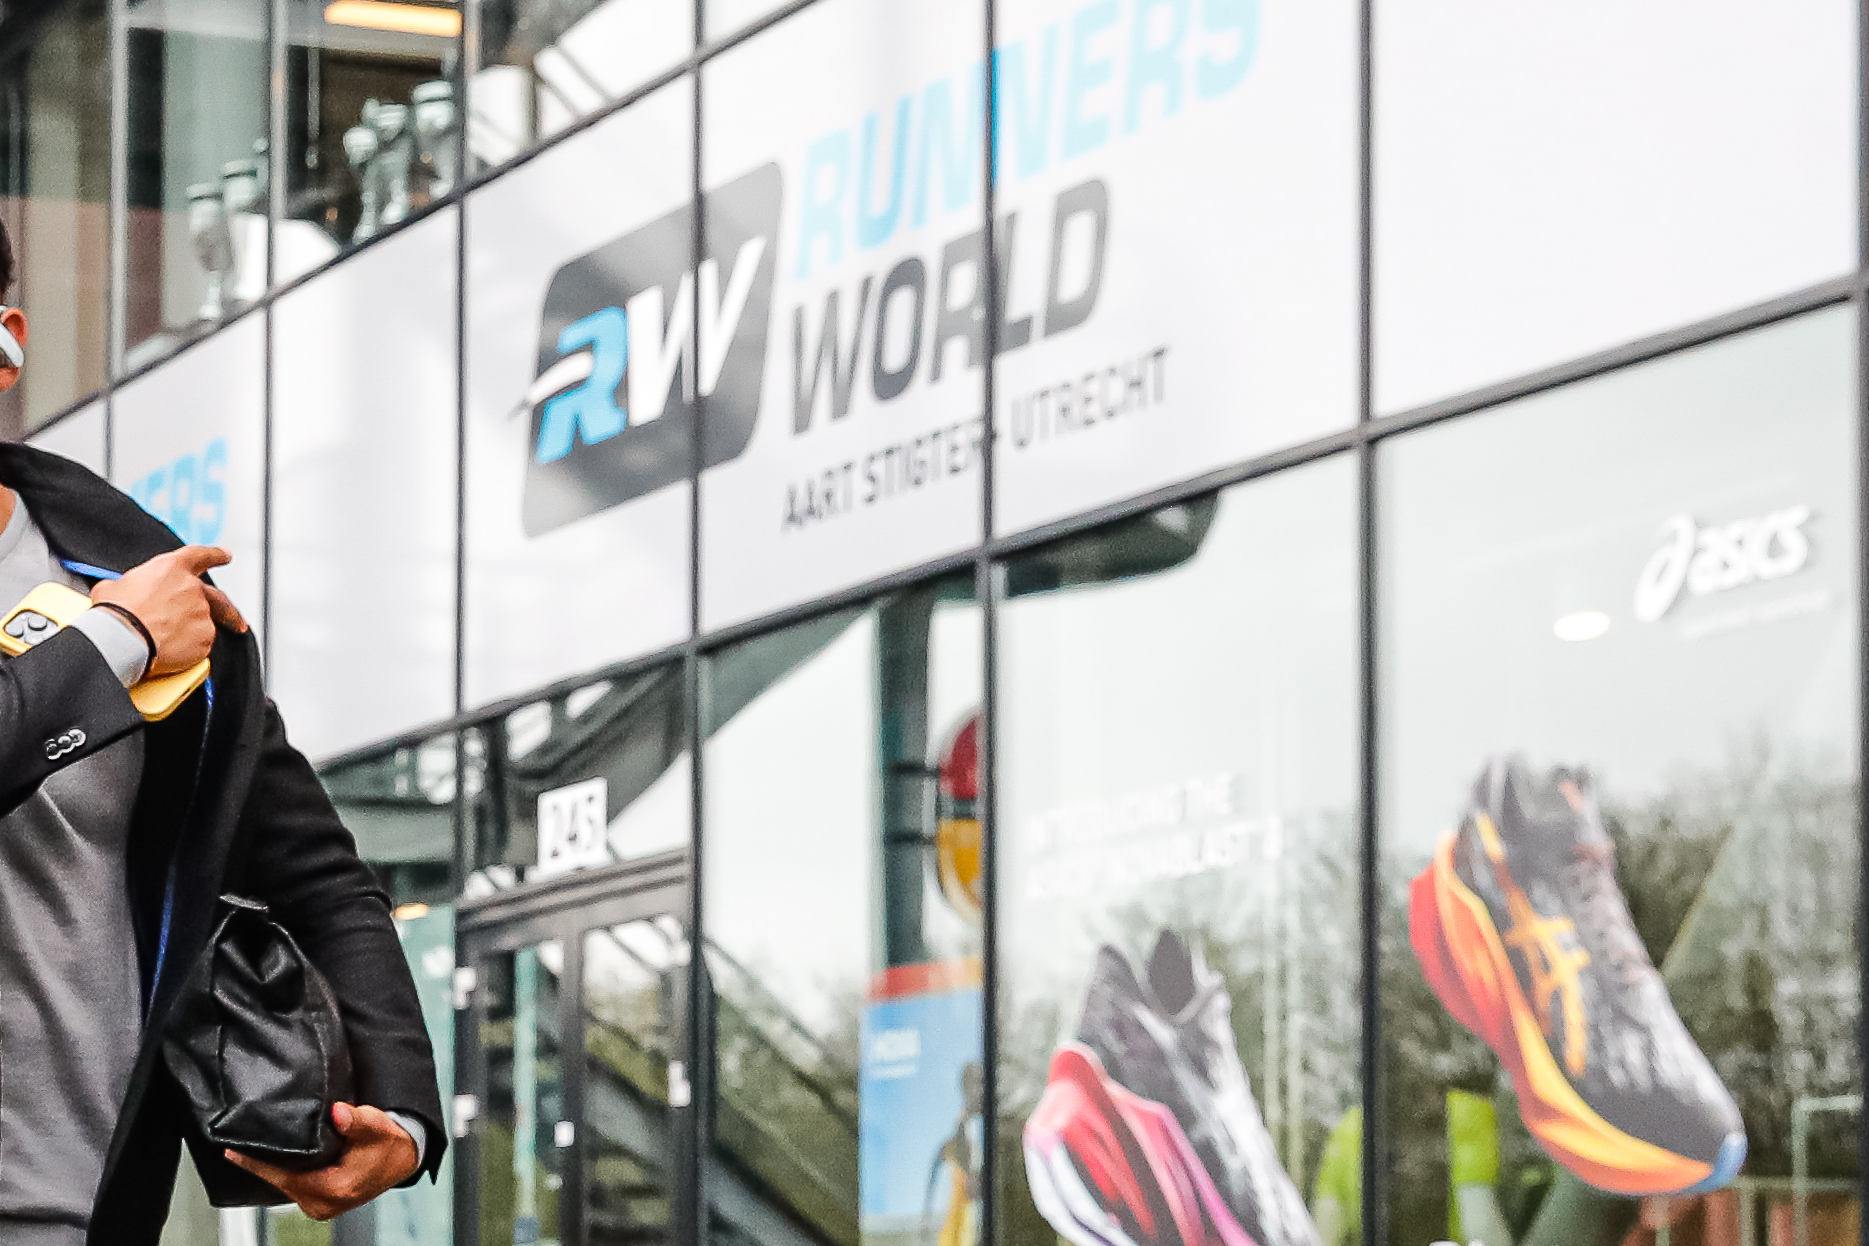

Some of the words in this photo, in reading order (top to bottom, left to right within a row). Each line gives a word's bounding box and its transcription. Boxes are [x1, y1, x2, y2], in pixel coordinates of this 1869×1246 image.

[794, 0, 1260, 282] RUNNERS
[792, 179, 1108, 434] WORLD
[1010, 345, 1169, 452] UTRECHT
